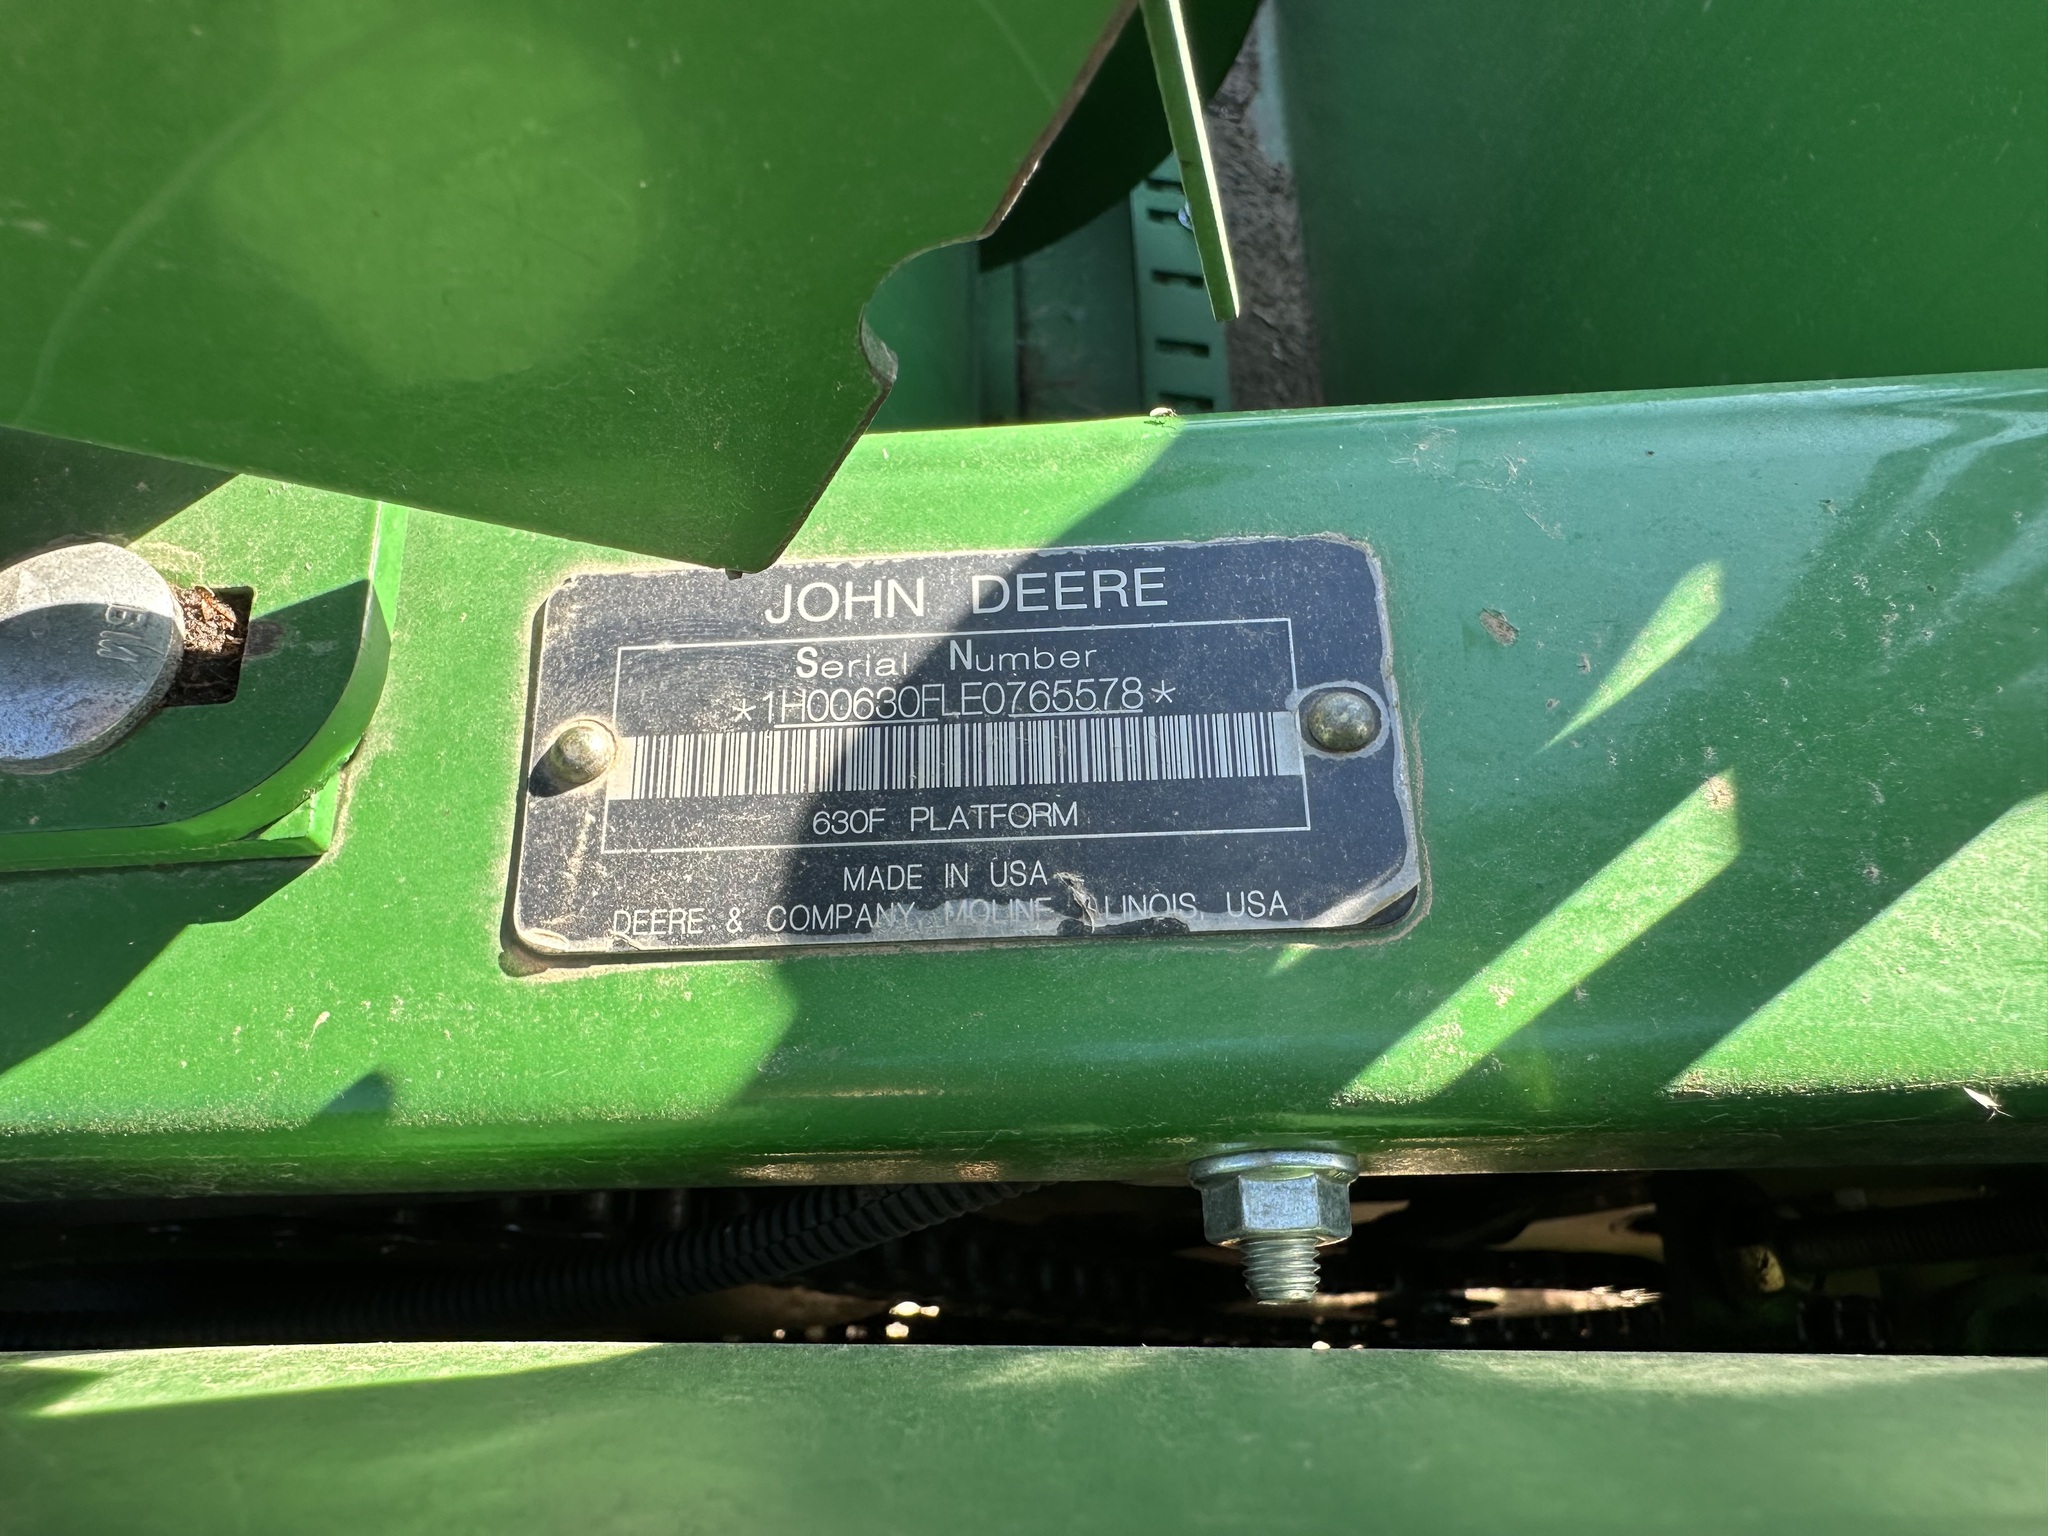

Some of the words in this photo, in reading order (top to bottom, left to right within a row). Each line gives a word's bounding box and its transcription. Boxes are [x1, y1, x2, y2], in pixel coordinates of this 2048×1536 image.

[765, 577, 925, 625] JOHN
[971, 566, 1169, 615] DEERE
[795, 645, 908, 680] Serial
[949, 638, 1098, 672] Number
[812, 807, 887, 836] 630F
[909, 801, 1078, 832] PLATFORM
[843, 863, 923, 893] MADE
[944, 862, 970, 889] IN
[990, 859, 1048, 888] USA
[612, 907, 705, 936] DEERE
[725, 906, 744, 934] &
[1081, 891, 1205, 922] LINOIS,
[1226, 889, 1289, 918] USA
